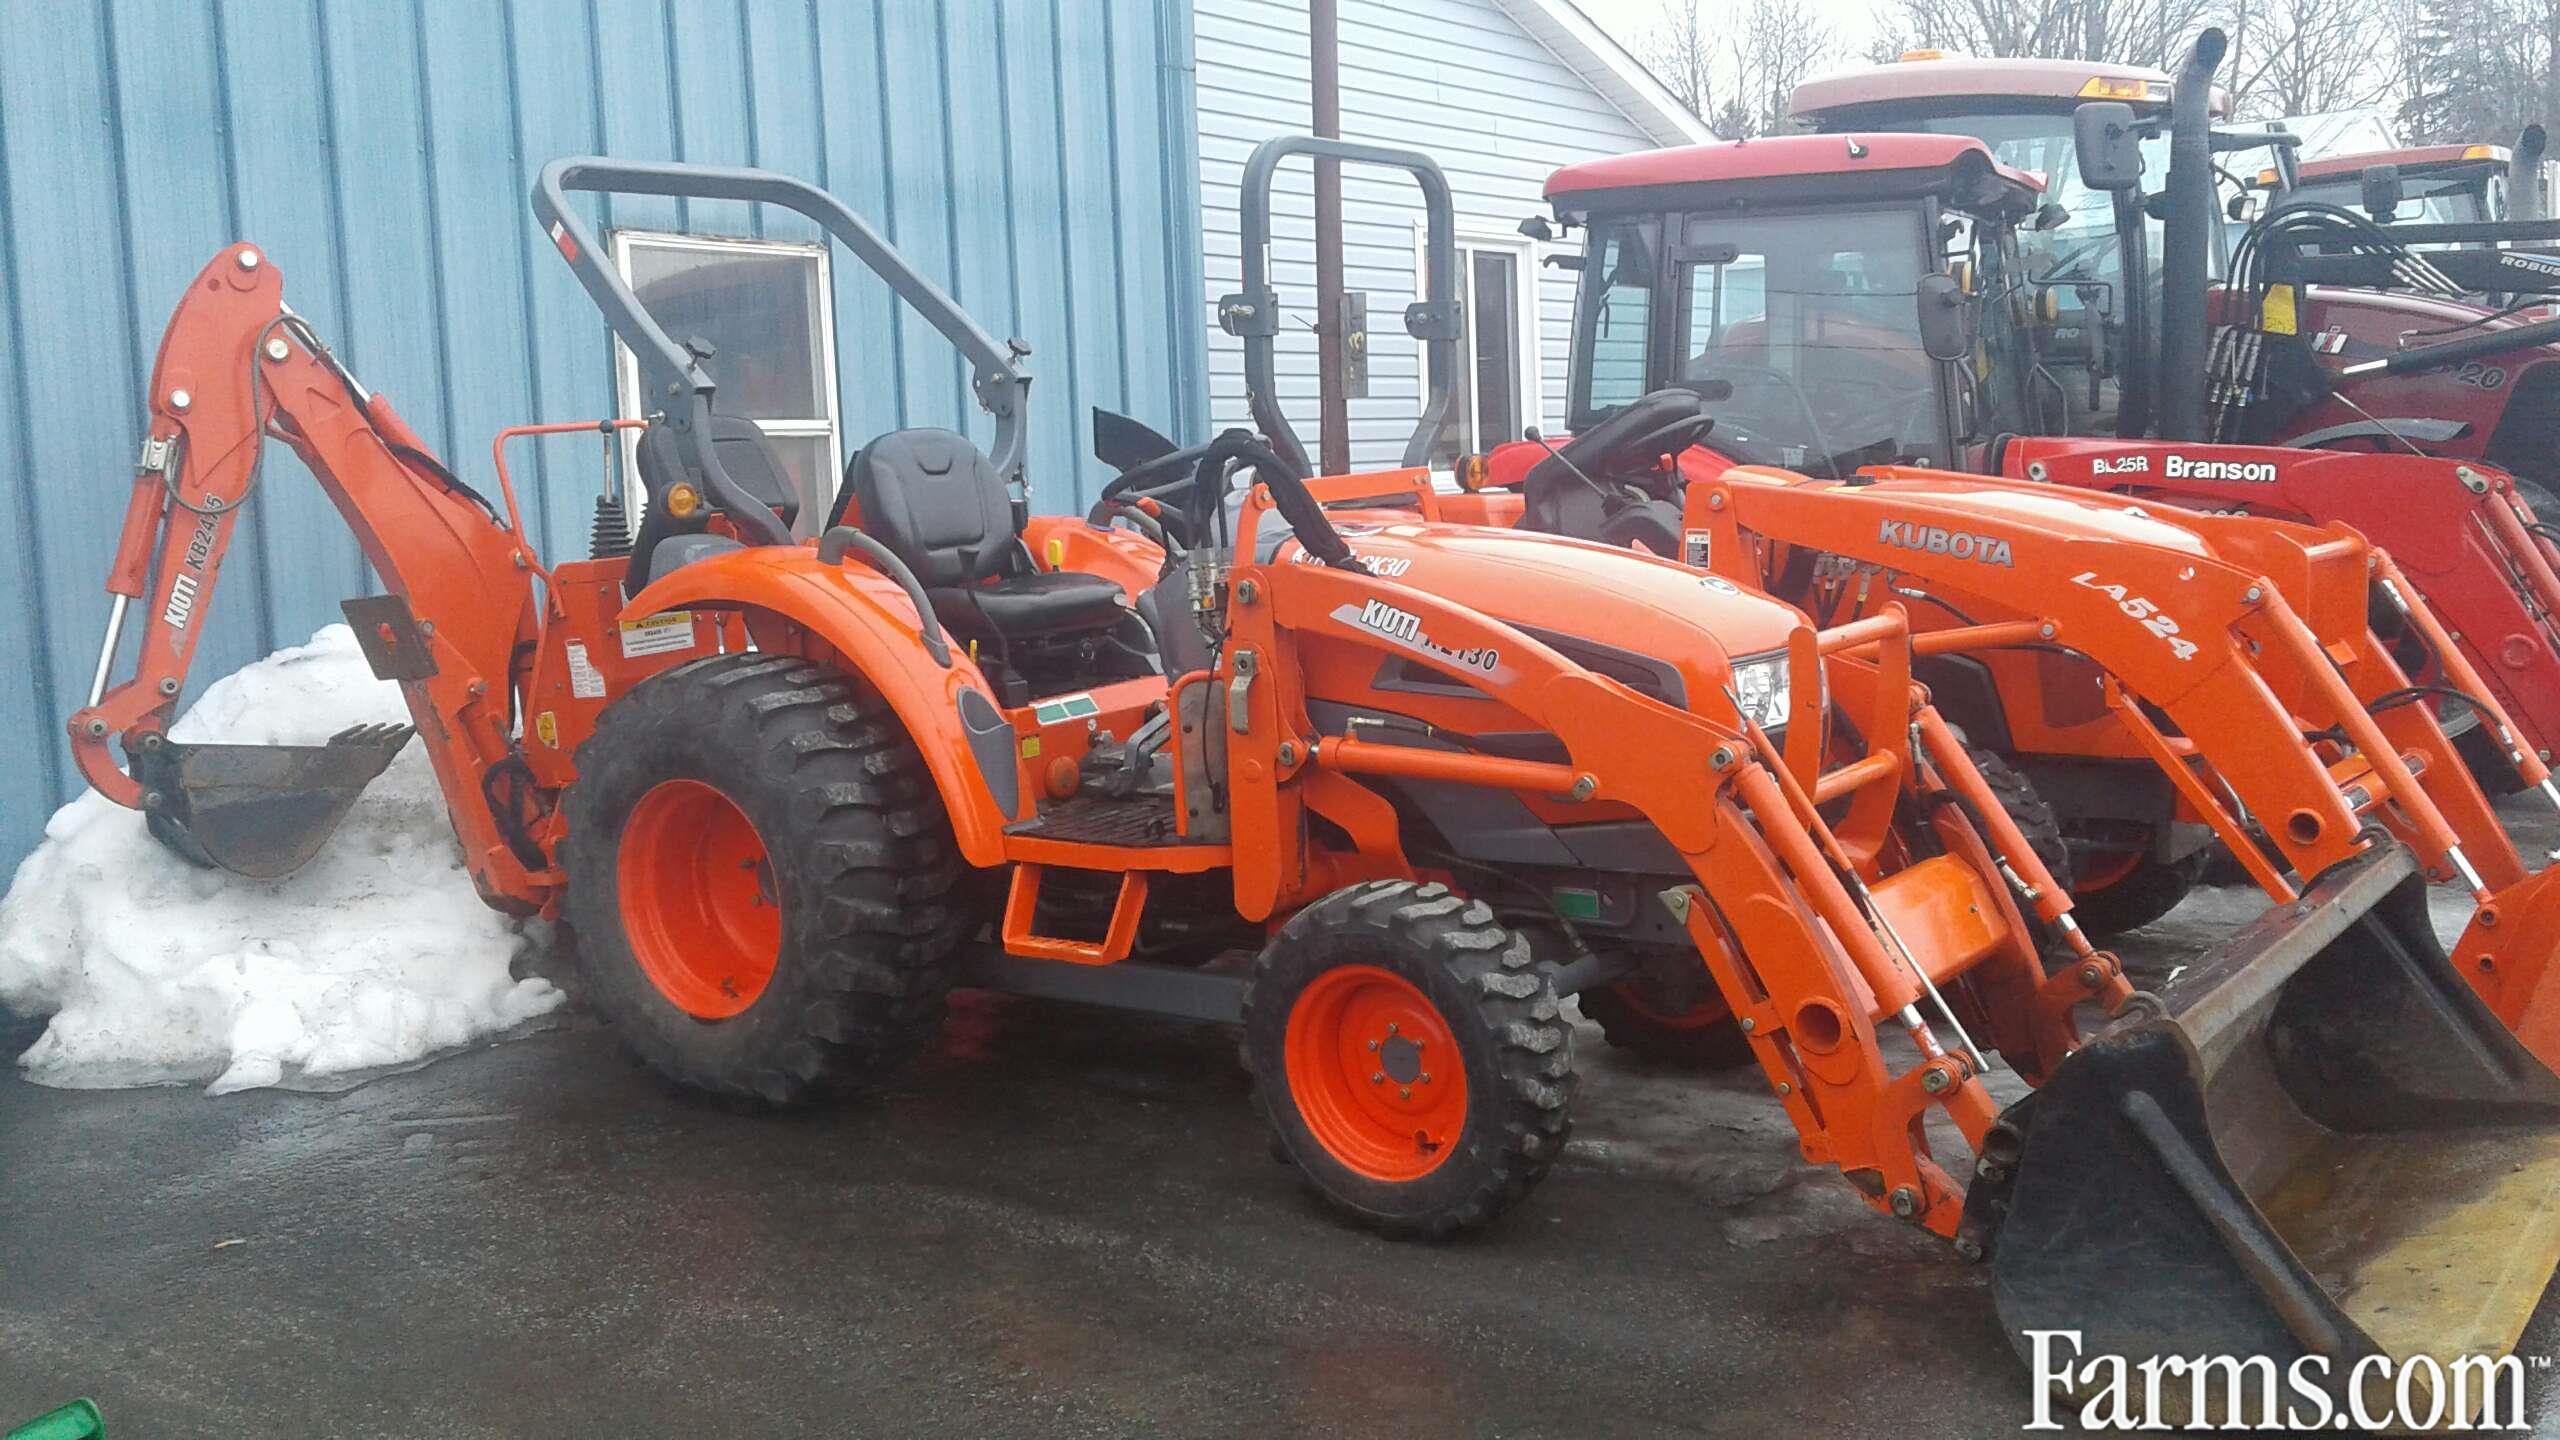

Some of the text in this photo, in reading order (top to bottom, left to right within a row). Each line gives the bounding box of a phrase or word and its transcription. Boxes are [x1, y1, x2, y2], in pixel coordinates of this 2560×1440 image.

[2456, 361, 2505, 390] 20
[2164, 455, 2277, 482] Branson
[1878, 517, 2016, 569] KUBOTA
[163, 571, 200, 631] KIOTI
[1359, 597, 1422, 642] KIOTI
[2069, 571, 2199, 661] LA524
